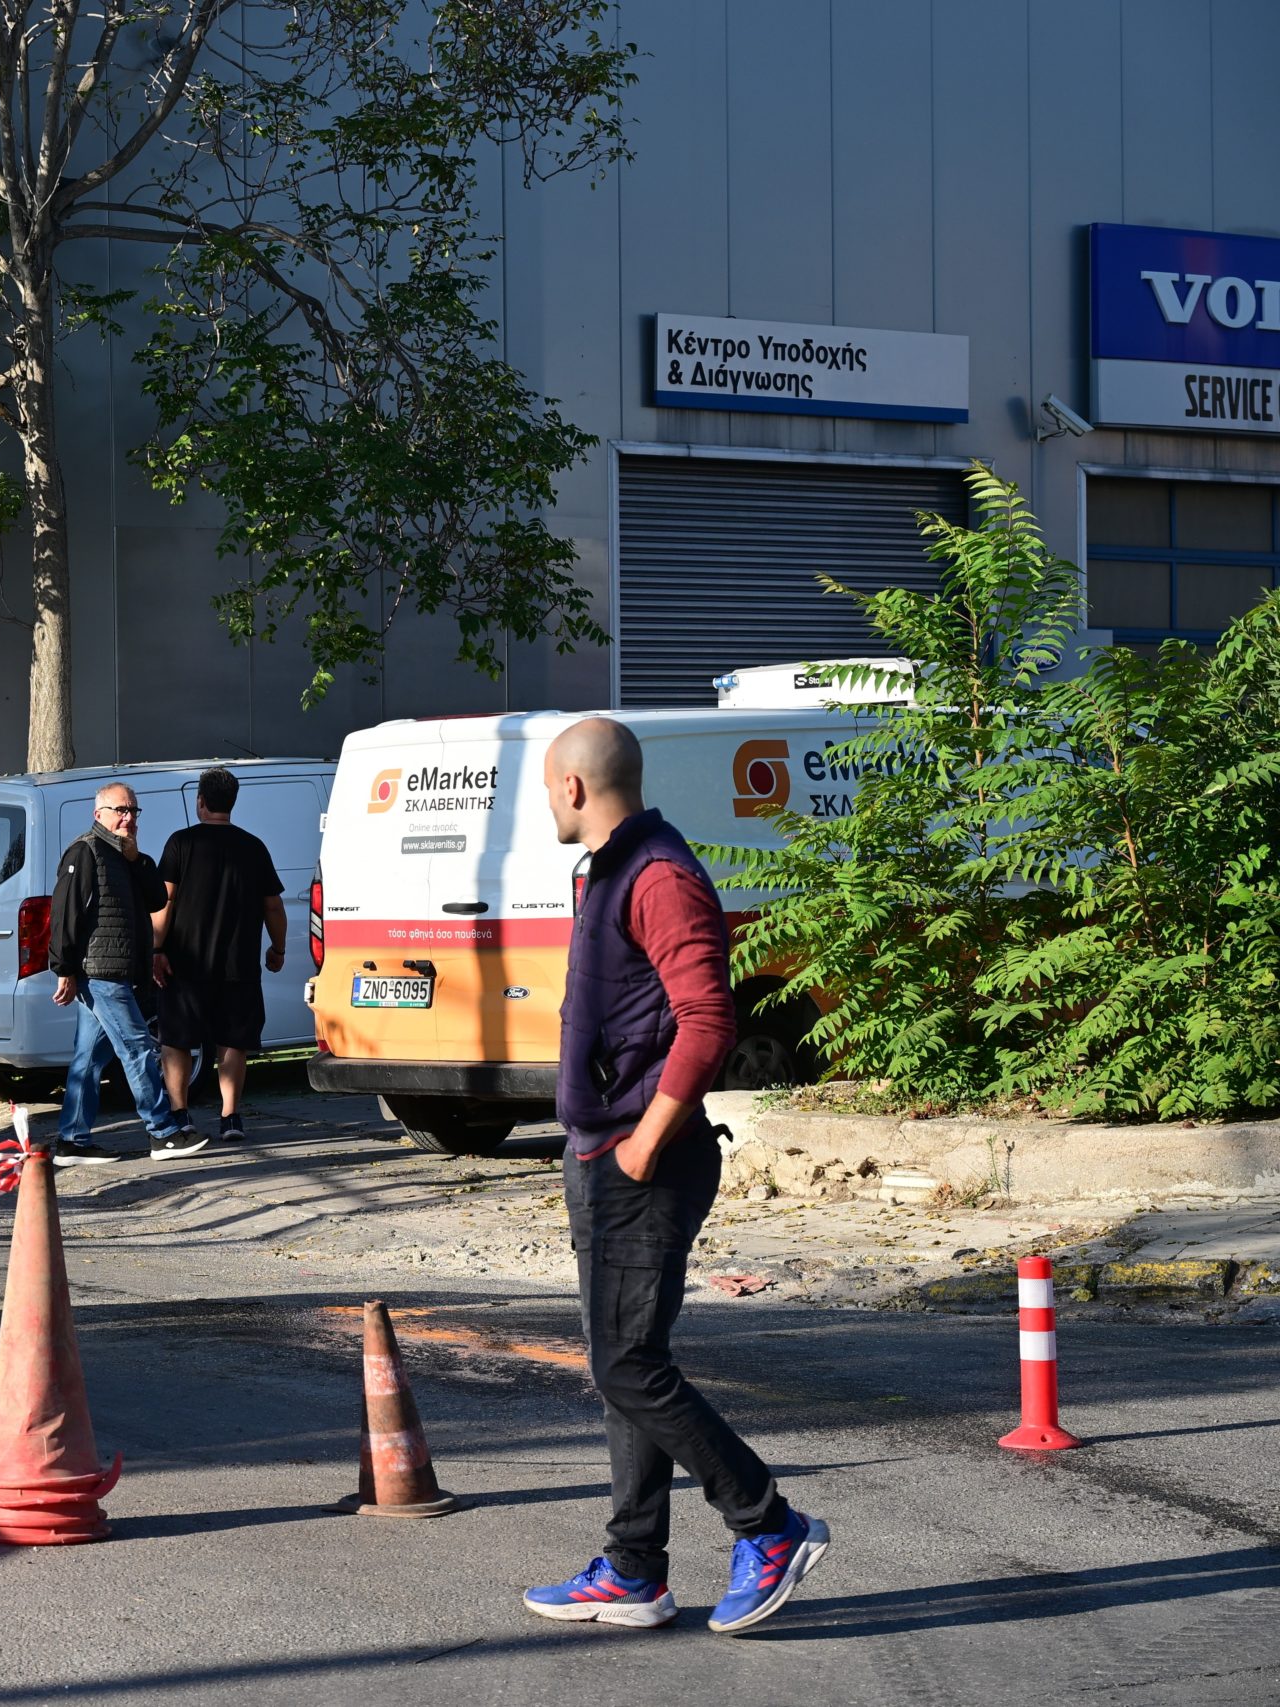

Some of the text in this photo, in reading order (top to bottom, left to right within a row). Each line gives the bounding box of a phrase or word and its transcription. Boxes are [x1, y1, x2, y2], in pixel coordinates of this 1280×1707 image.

[667, 328, 868, 372] Κέντρο Υποδοχής
[667, 358, 813, 399] & Διάγνωσης
[1184, 374, 1273, 421] SERVICE
[407, 765, 498, 792] eMarket
[405, 796, 496, 812] ΣΚΛΑΒΕΝΙΤΗΣ
[402, 839, 466, 850] www.sklavenitis.gr
[388, 928, 493, 940] τόσο φθηνά όσο πουθενά
[363, 980, 429, 1000] ZNO-6095
